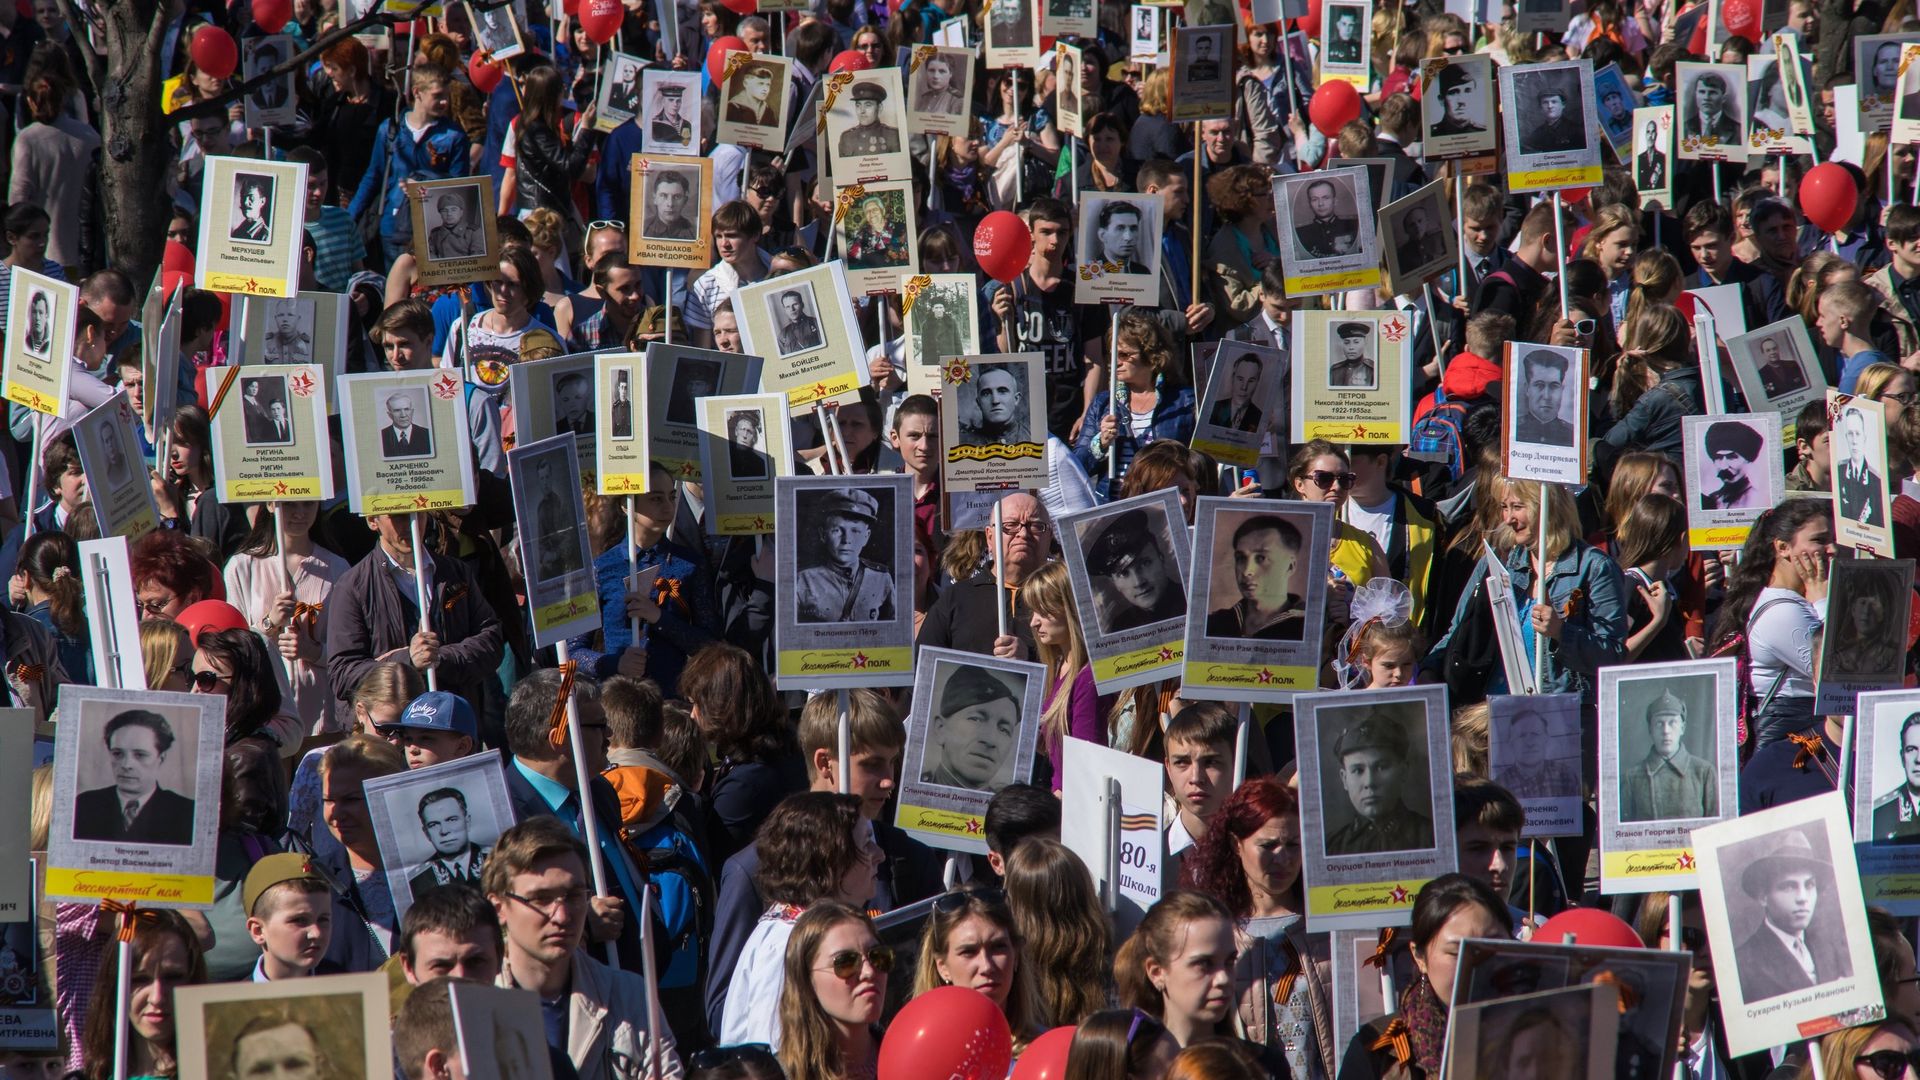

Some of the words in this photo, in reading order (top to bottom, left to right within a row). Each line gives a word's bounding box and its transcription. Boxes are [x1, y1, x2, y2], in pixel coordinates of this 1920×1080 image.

[231, 246, 265, 256] МЕРКУШЕВ
[646, 244, 692, 253] БОЛЬШАКОВ
[657, 252, 703, 262] ФЁДОРОВИЧ
[439, 260, 478, 268] СТЕПАНОВ
[421, 270, 446, 278] ПАВЕЛ
[447, 266, 497, 275] СТЕПАНОВИЧ
[258, 287, 277, 295] ПОЛК
[791, 356, 820, 368] БОЙЦЕВ
[800, 360, 836, 374] Матвеевич
[829, 384, 849, 394] ПОЛК
[1344, 400, 1390, 408] Никандрович
[1368, 432, 1390, 440] ПОЛК
[242, 456, 259, 464] Анна
[260, 455, 301, 464] Николаевна
[1511, 450, 1533, 461] Федор
[1534, 453, 1579, 463] Дмитриевич
[389, 462, 430, 471] ХАРЧЕНКО
[987, 461, 1006, 471] Попов
[239, 472, 263, 480] Сергей
[264, 471, 304, 479] Васильевич
[376, 471, 408, 479] Василий
[409, 469, 444, 477] Иванович
[955, 469, 985, 477] Дмитрий
[986, 466, 1039, 475] Константинович
[290, 487, 311, 495] ПОЛК
[736, 485, 764, 493] ЕРОШКОВ
[430, 500, 453, 509] ПОЛК
[814, 630, 858, 639] Филоненко
[858, 628, 878, 638] Пётр
[1095, 638, 1121, 649] Ахутин
[1121, 629, 1157, 643] Владимир
[1210, 643, 1234, 653] Жуков
[1173, 651, 1184, 661] ПО
[867, 659, 890, 668] ПОЛК
[1271, 676, 1295, 685] ПОЛК
[903, 786, 951, 800] Спинчевский
[951, 793, 984, 805] Дмитрий
[1615, 830, 1643, 839] Яганов
[1644, 828, 1676, 838] Георгий
[90, 857, 120, 866] Виктор
[121, 858, 173, 869] Васильевич
[1326, 863, 1363, 873] Огурцов
[1364, 861, 1391, 870] Павел
[1393, 857, 1437, 868] Иванович
[1746, 1004, 1781, 1018] Сухарев
[1782, 997, 1813, 1010] Кузьма
[1814, 984, 1856, 1001] Иванович
